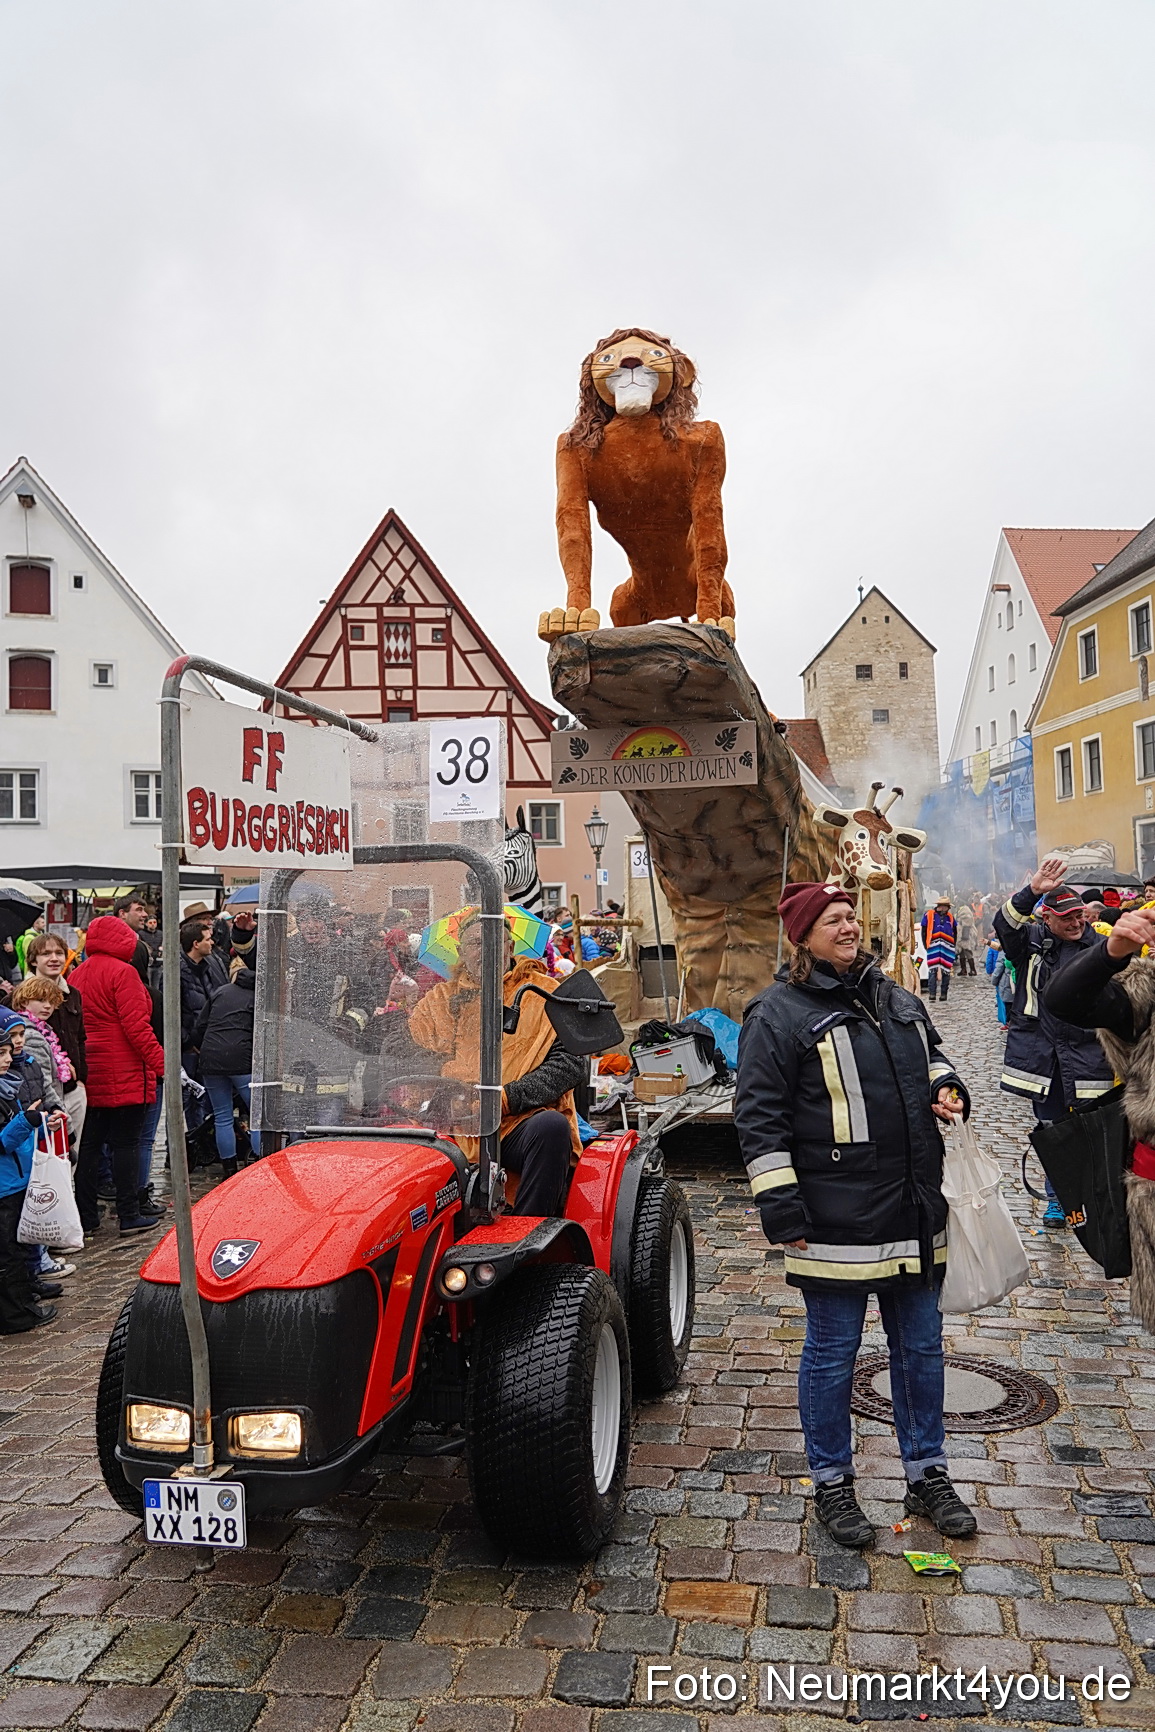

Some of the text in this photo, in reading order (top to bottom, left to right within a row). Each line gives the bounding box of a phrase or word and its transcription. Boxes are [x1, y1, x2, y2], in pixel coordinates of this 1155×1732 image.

[603, 725, 703, 756] HAKUNA MATATA
[242, 727, 285, 793] FF
[436, 736, 491, 786] 38
[580, 757, 737, 786] DER KÖNIG DER LÖWEN
[150, 1497, 157, 1507] D
[166, 1485, 199, 1512] NM
[152, 1513, 238, 1543] XX 128
